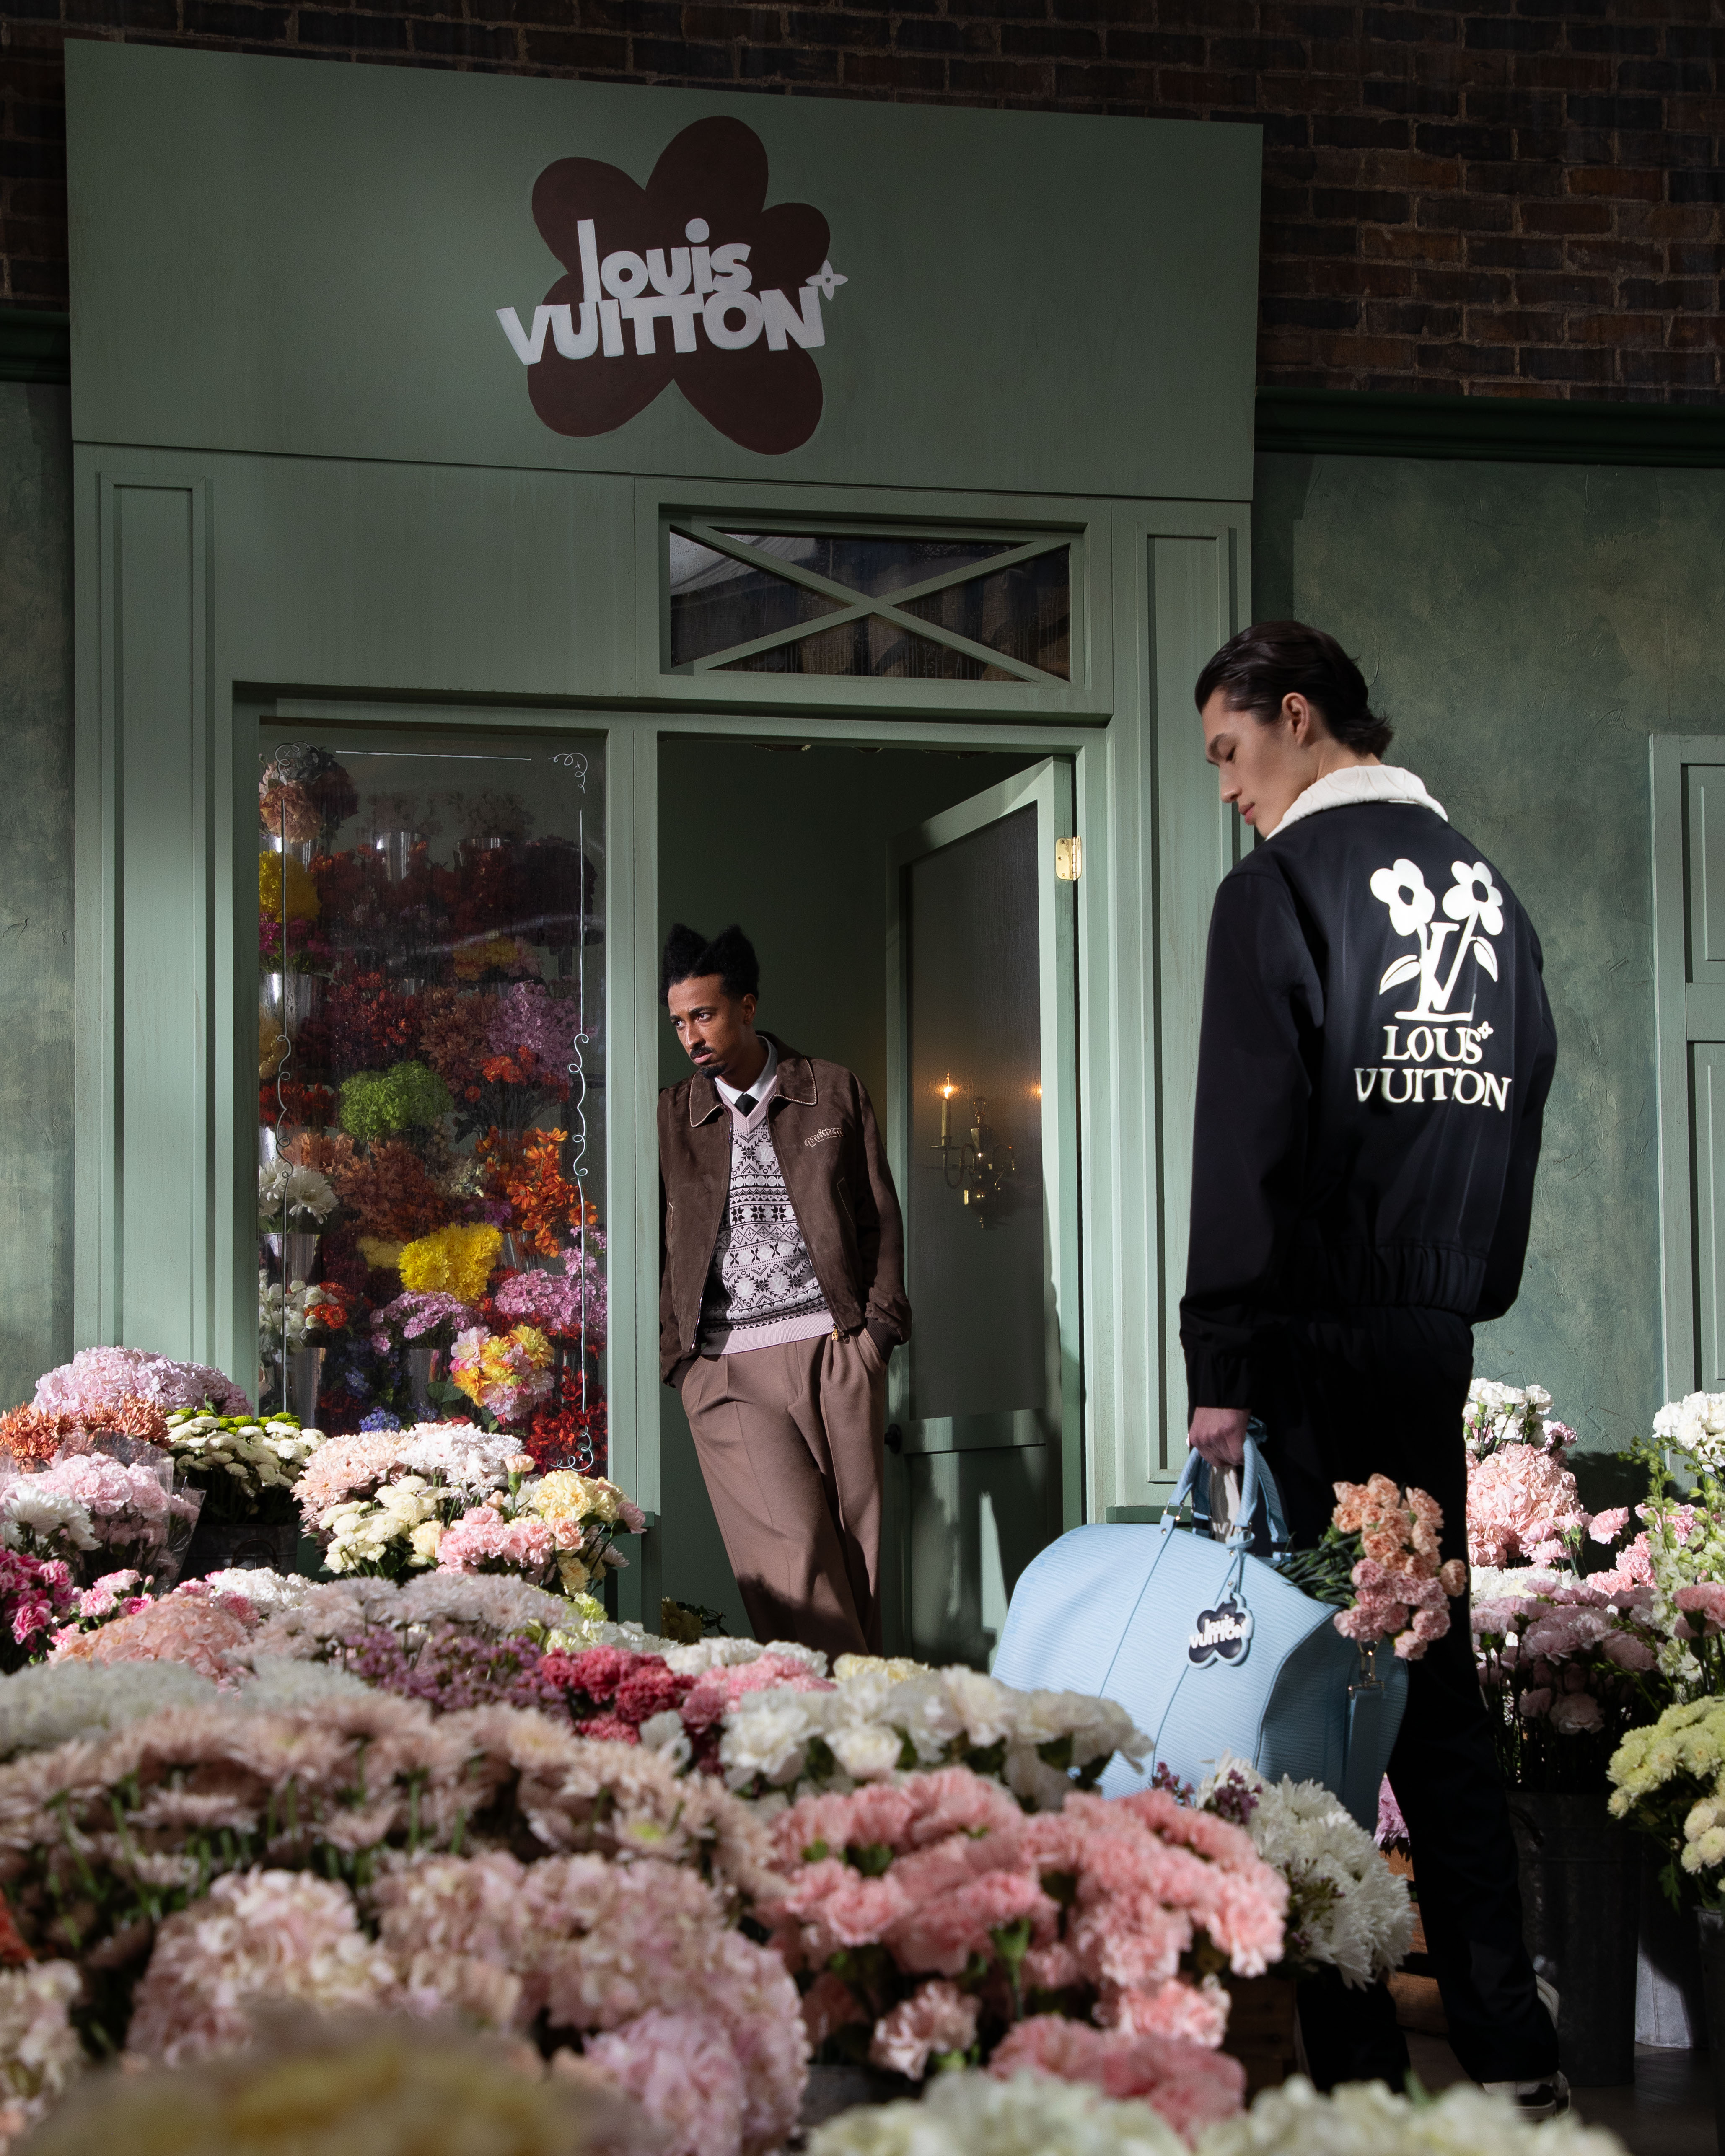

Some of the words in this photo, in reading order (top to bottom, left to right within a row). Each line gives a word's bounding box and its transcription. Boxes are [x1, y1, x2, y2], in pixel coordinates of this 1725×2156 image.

[496, 286, 825, 365] VUITTON
[1382, 1025, 1482, 1064] LOUS
[1353, 1067, 1512, 1112] VUITON
